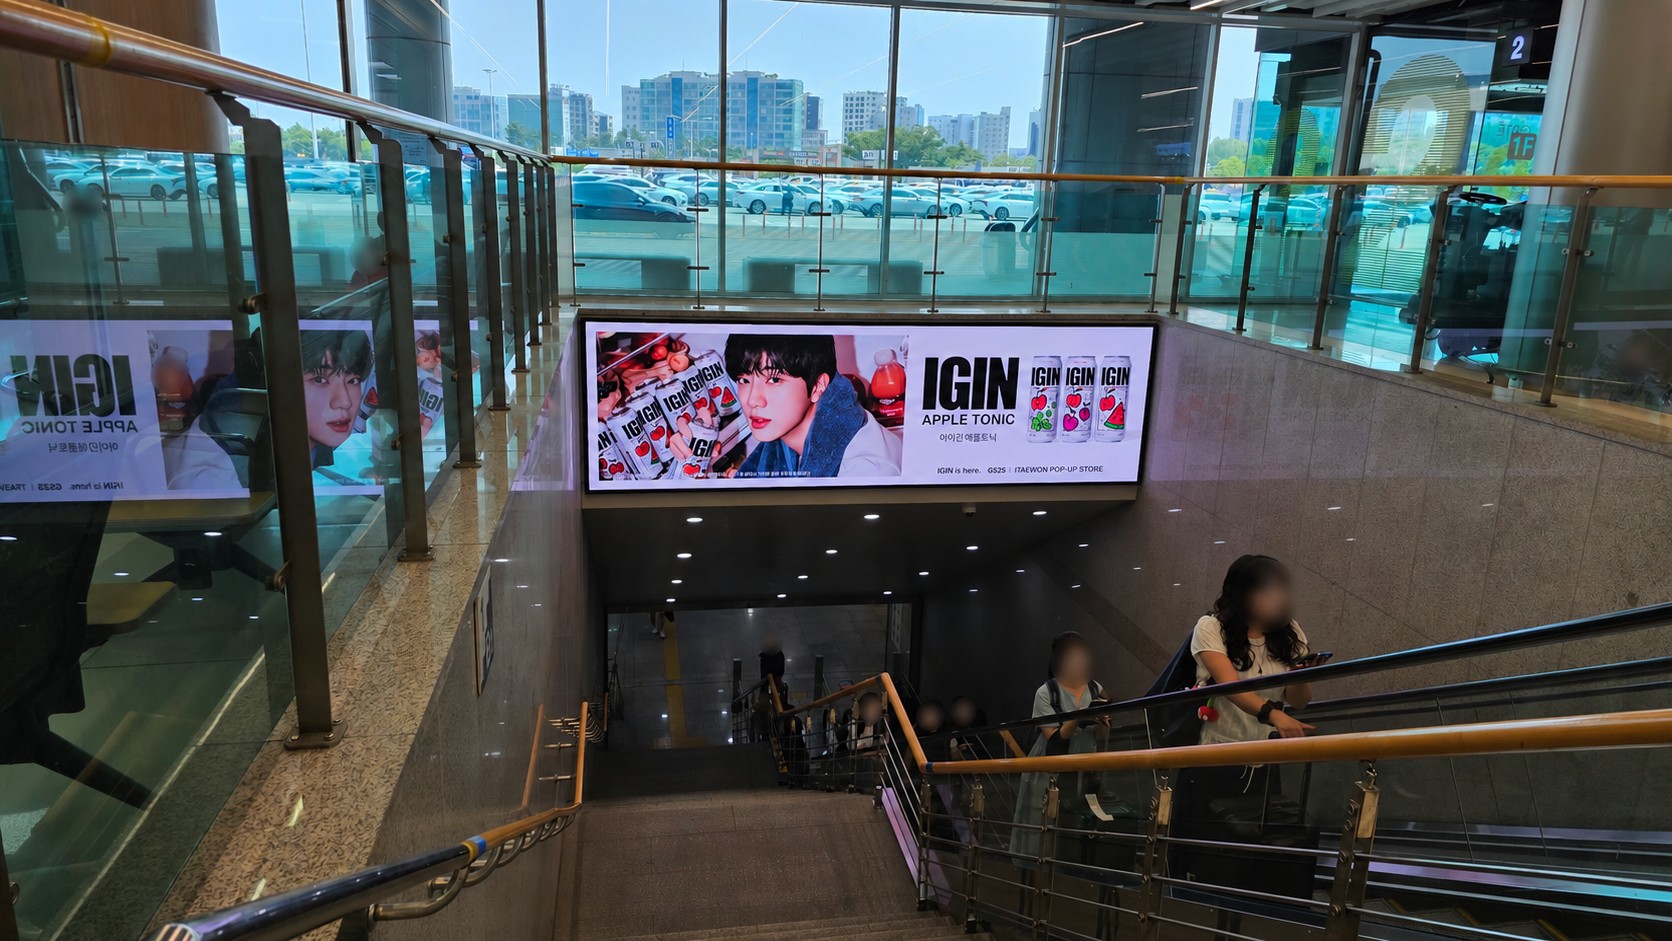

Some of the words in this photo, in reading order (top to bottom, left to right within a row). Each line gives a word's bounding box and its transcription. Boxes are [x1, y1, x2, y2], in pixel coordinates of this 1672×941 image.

[1510, 35, 1525, 60] 2
[1512, 136, 1534, 156] 1F
[922, 356, 1020, 411] IGIN
[1031, 367, 1060, 386] IGIN
[1066, 367, 1095, 386] IGIN
[1101, 367, 1130, 386] IGIN
[922, 414, 968, 426] APPLE
[972, 413, 1015, 426] TONIC
[937, 467, 954, 475] IGIN
[1079, 465, 1104, 473] STORE
